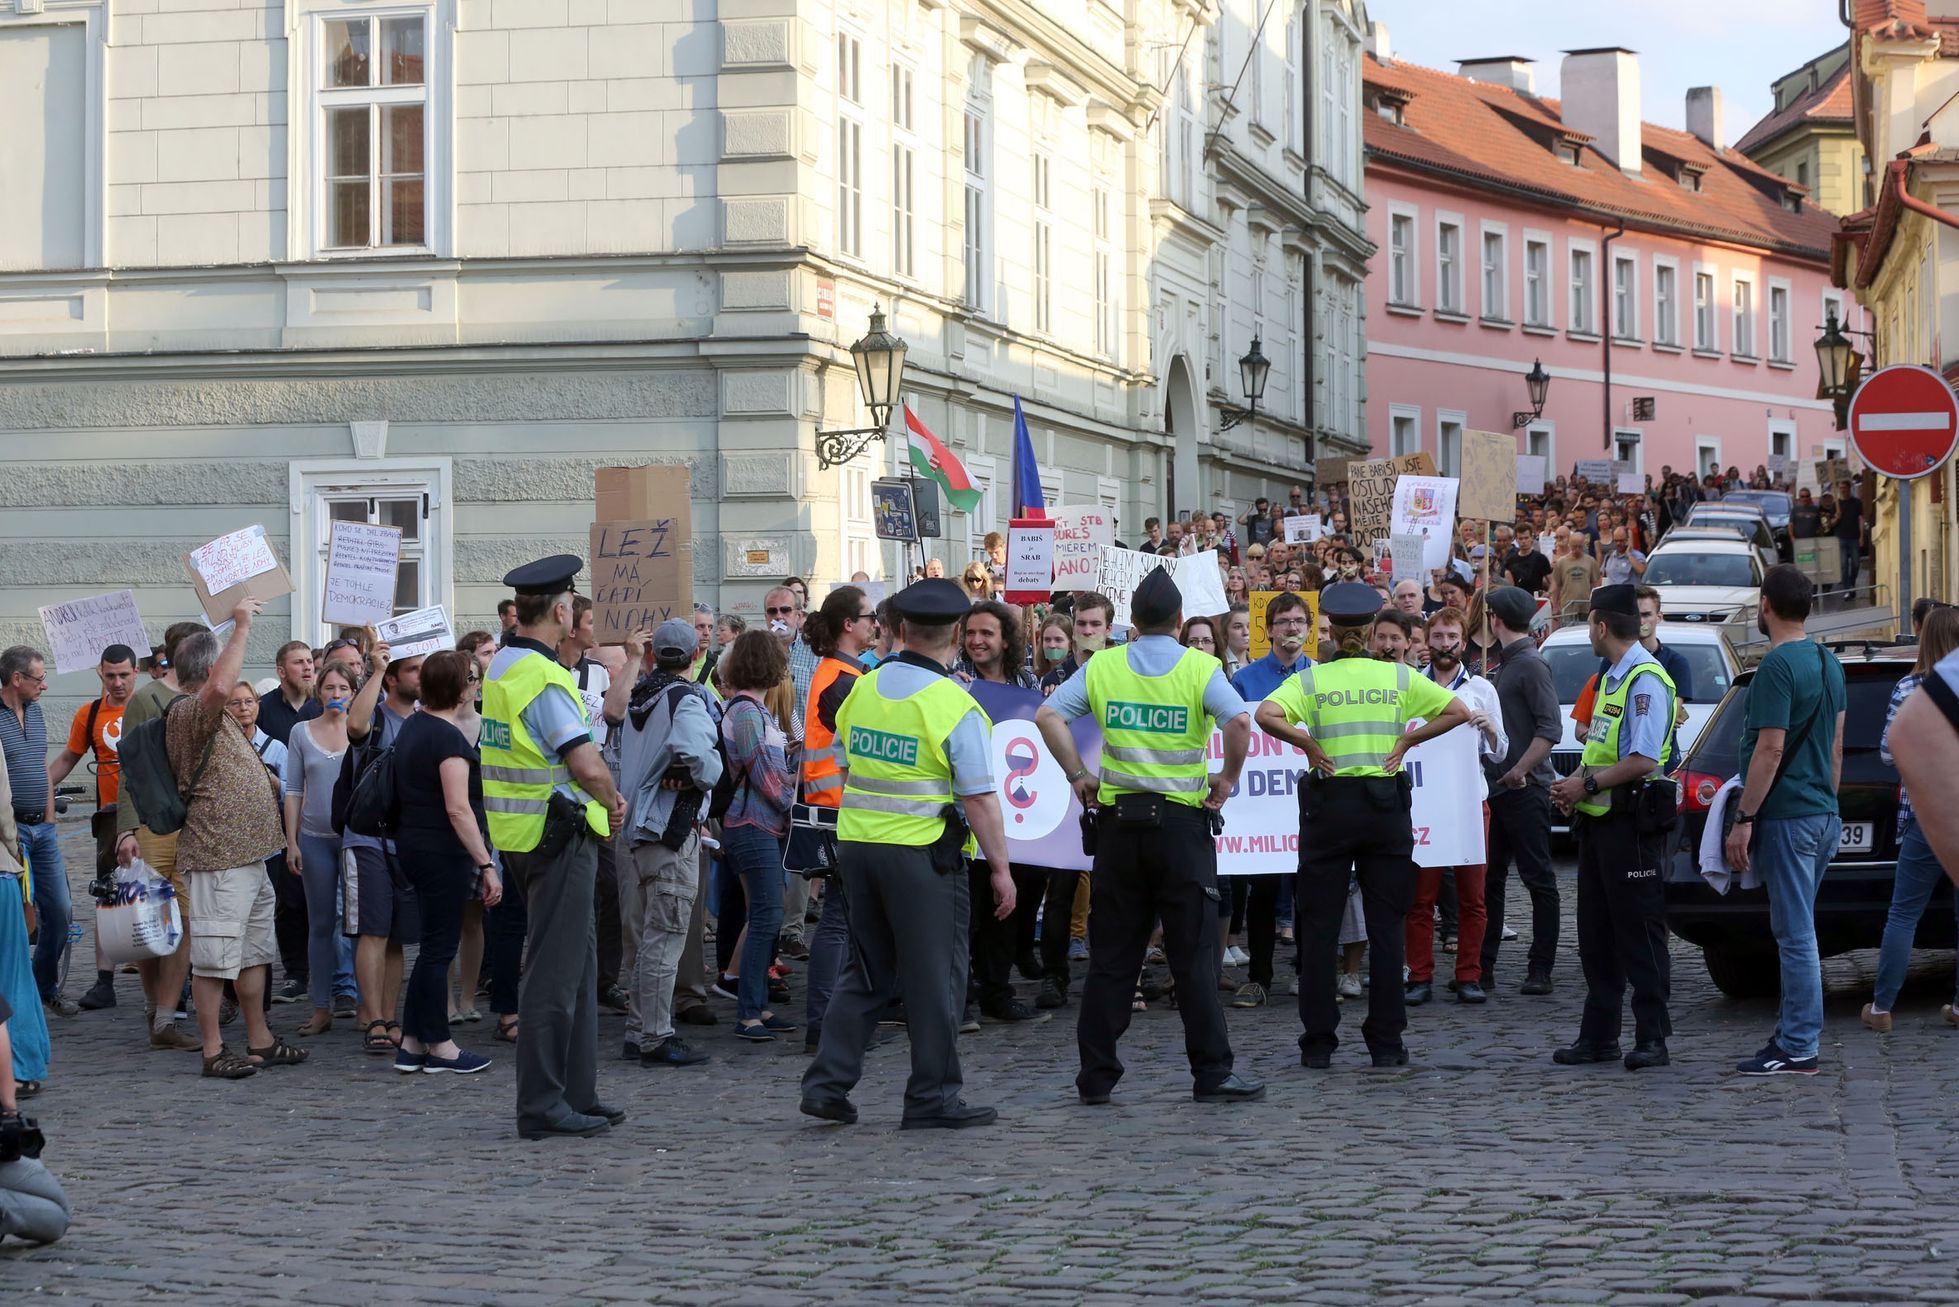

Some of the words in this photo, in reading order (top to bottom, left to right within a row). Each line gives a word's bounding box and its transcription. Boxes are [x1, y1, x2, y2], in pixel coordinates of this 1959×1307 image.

[1350, 464, 1366, 478] PANE
[1403, 457, 1423, 473] JSTE
[1080, 515, 1103, 526] STB
[597, 519, 672, 559] LEŽ
[1020, 534, 1043, 542] BABIŠ
[1353, 526, 1391, 548] DŮSTO
[612, 557, 640, 584] MÁ
[1018, 576, 1039, 584] debaty
[330, 577, 341, 587] JE
[344, 578, 373, 592] TOHLE
[329, 590, 393, 615] DEMOKRACIE?
[604, 606, 671, 632] NOHY
[406, 638, 441, 655] STOP!
[580, 692, 599, 708] BEZ
[1314, 688, 1399, 709] POLICIE
[1107, 705, 1187, 729] POLICIE
[850, 730, 917, 762] POLICIE
[1841, 825, 1864, 845] 39
[1627, 868, 1657, 879] POLICIE
